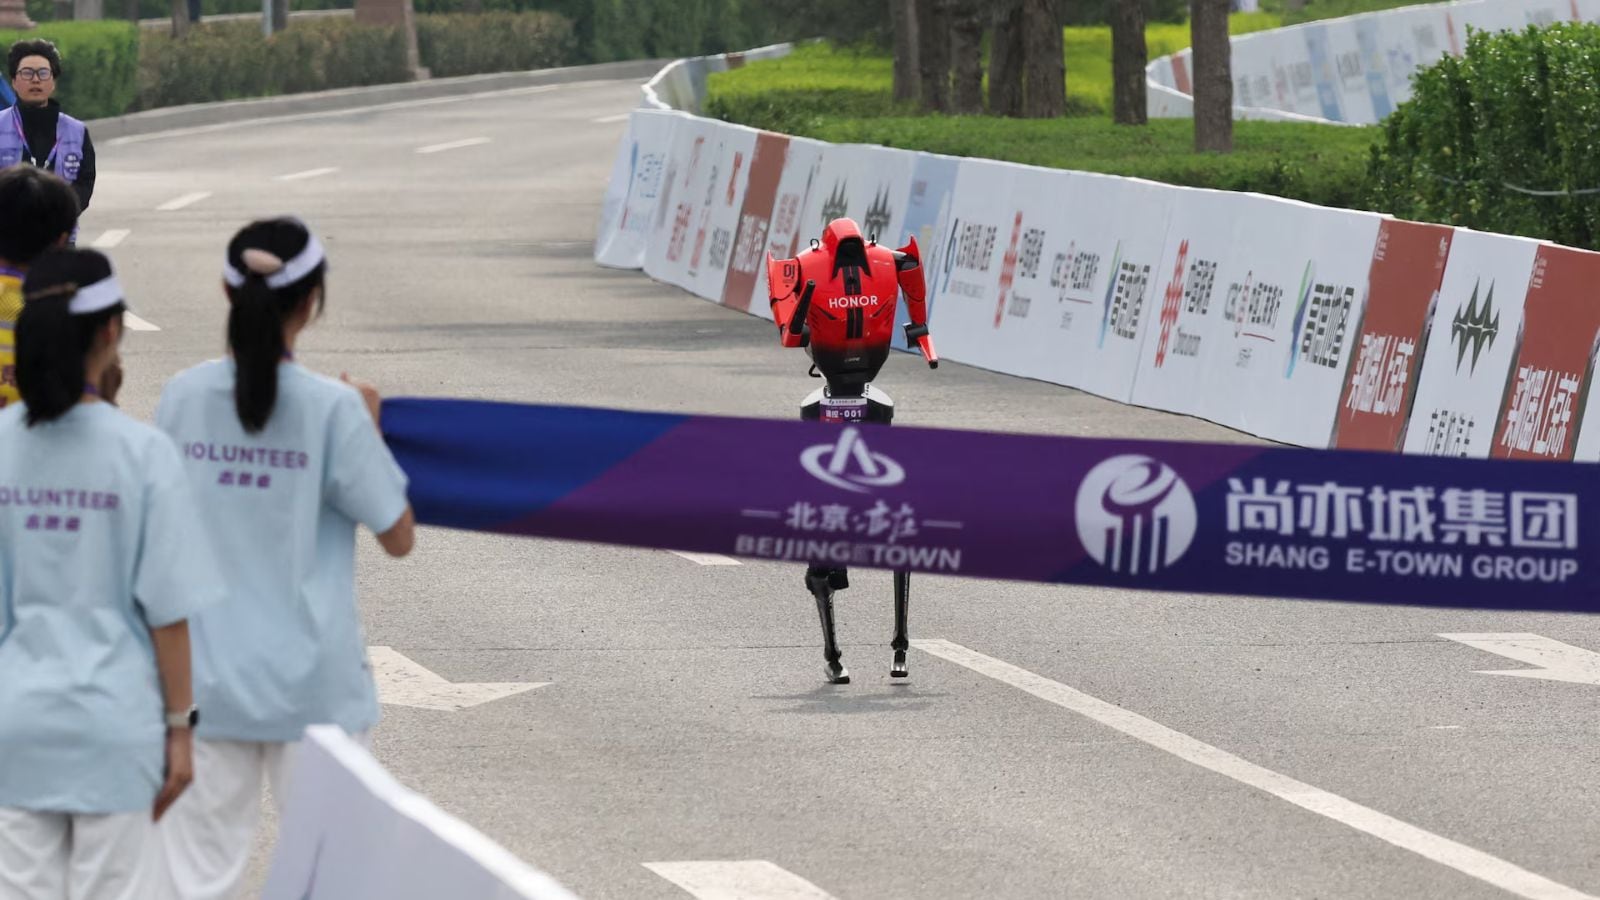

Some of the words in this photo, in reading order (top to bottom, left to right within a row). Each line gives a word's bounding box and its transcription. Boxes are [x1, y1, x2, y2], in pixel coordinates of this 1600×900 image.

[829, 295, 878, 309] HONOR
[0, 486, 119, 511] OLUNTEER
[1226, 478, 1578, 549] 尚亦城集团
[1225, 541, 1330, 570] SHANG
[1345, 548, 1464, 577] E-TOWN
[1471, 554, 1579, 582] GROUP
